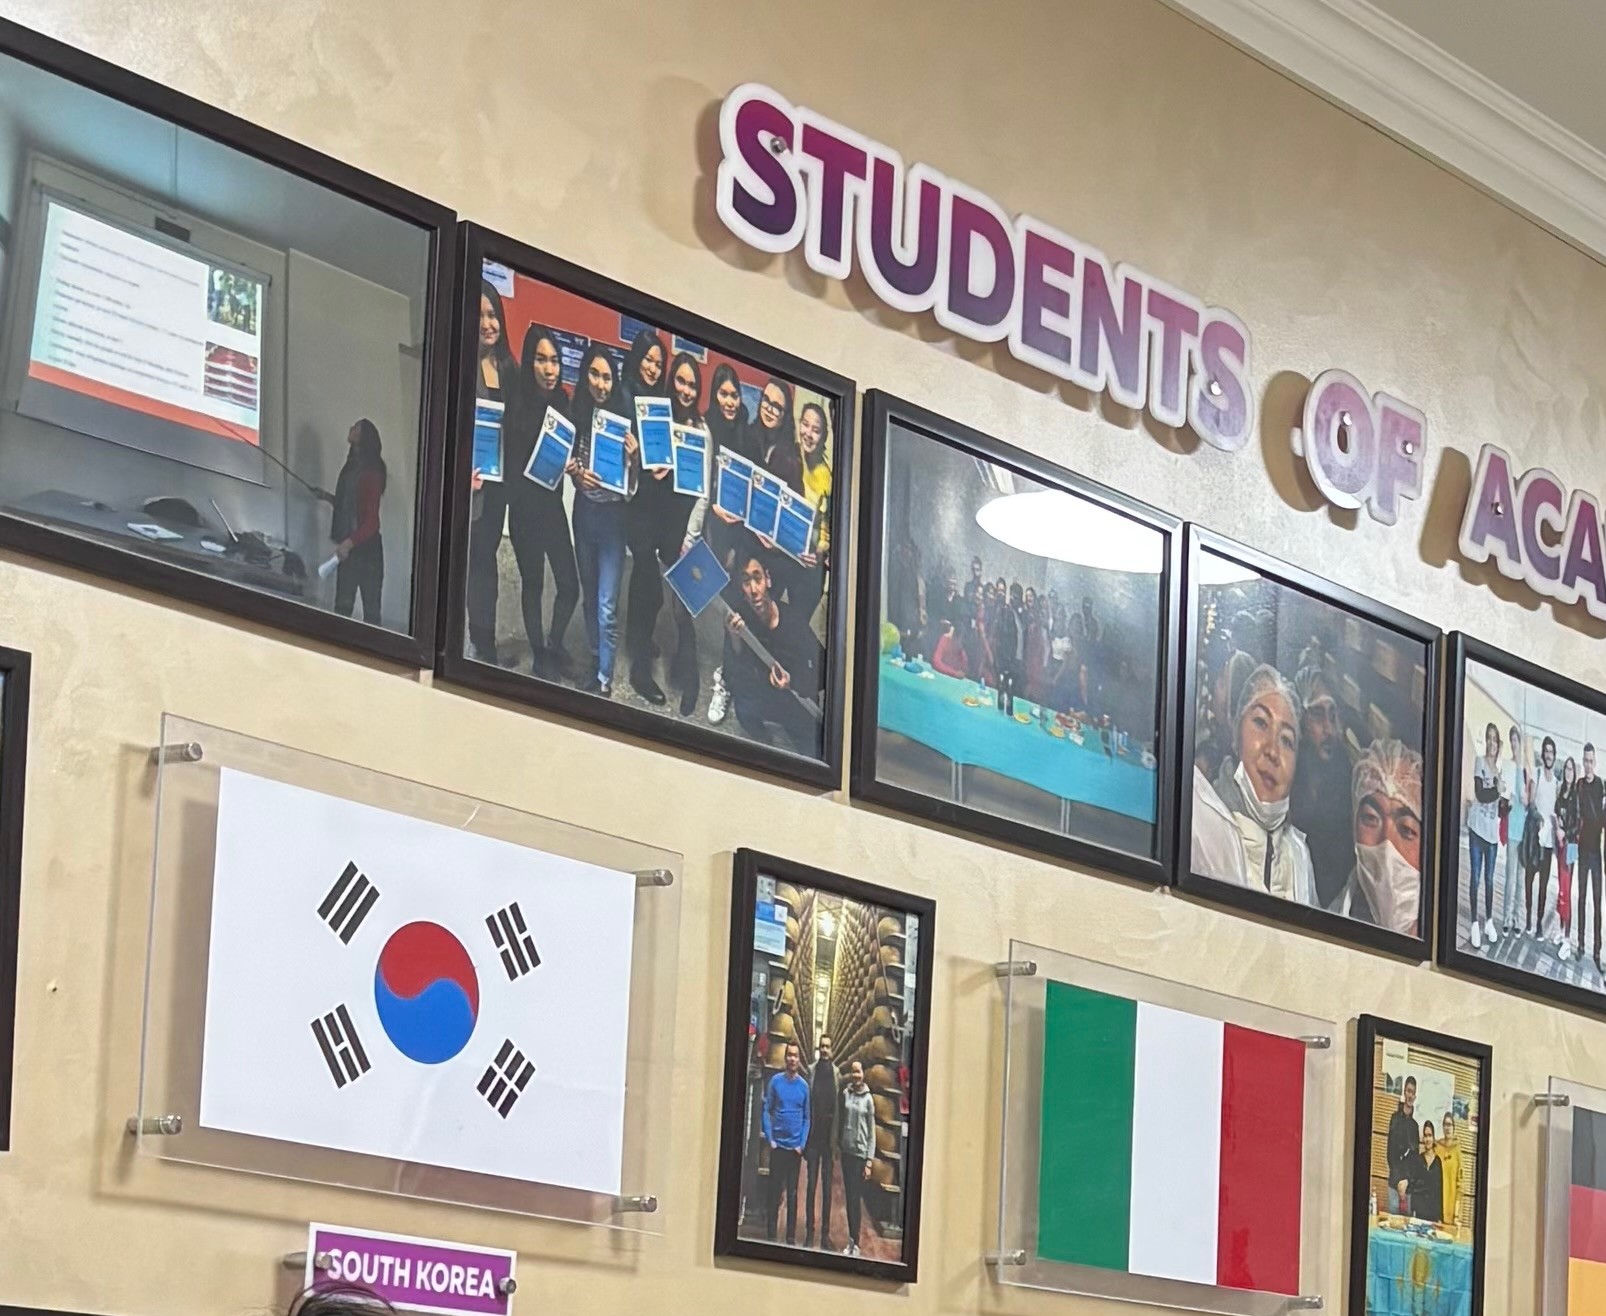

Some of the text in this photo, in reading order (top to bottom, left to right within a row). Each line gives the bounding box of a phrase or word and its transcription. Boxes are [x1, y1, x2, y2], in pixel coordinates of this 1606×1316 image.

[732, 99, 1247, 438] STUDENTS
[1315, 381, 1422, 513] OF
[327, 1248, 496, 1299] SOUTH KOREA
